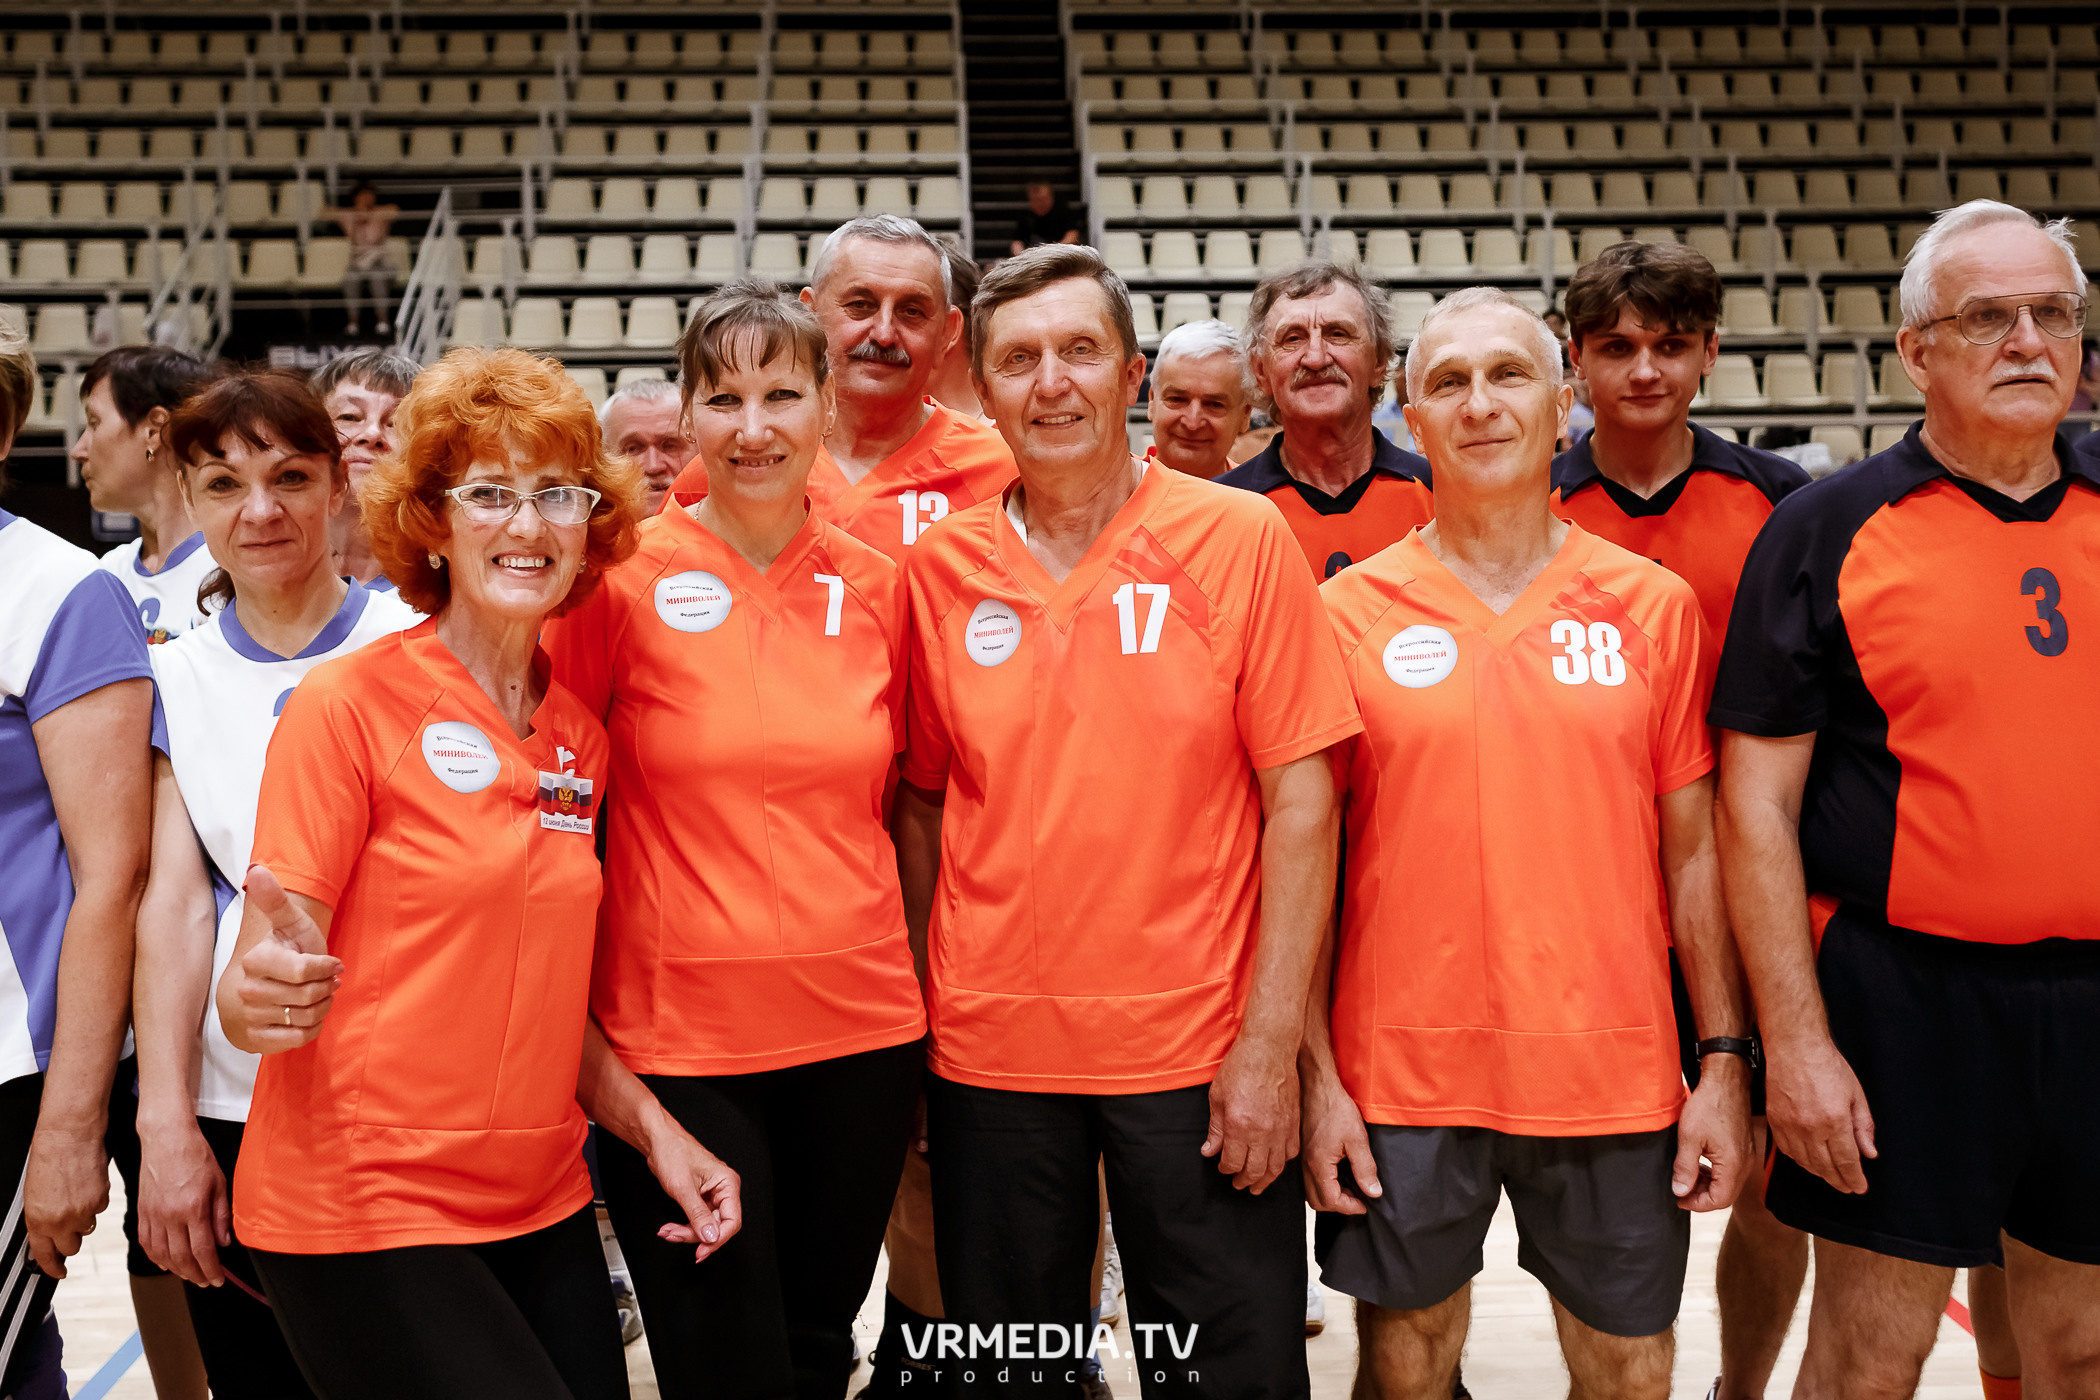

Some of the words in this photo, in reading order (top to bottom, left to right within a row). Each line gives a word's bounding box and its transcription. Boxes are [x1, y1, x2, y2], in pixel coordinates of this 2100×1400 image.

[666, 595, 721, 605] МИНИВОЛЕЙ
[813, 572, 844, 636] 7
[974, 626, 1014, 638] МИНИВОЛЕЙ
[1112, 582, 1171, 655] 17
[2020, 567, 2068, 657] 3
[1393, 650, 1447, 661] МИНИВОЛЕЙ
[1550, 619, 1627, 687] 38
